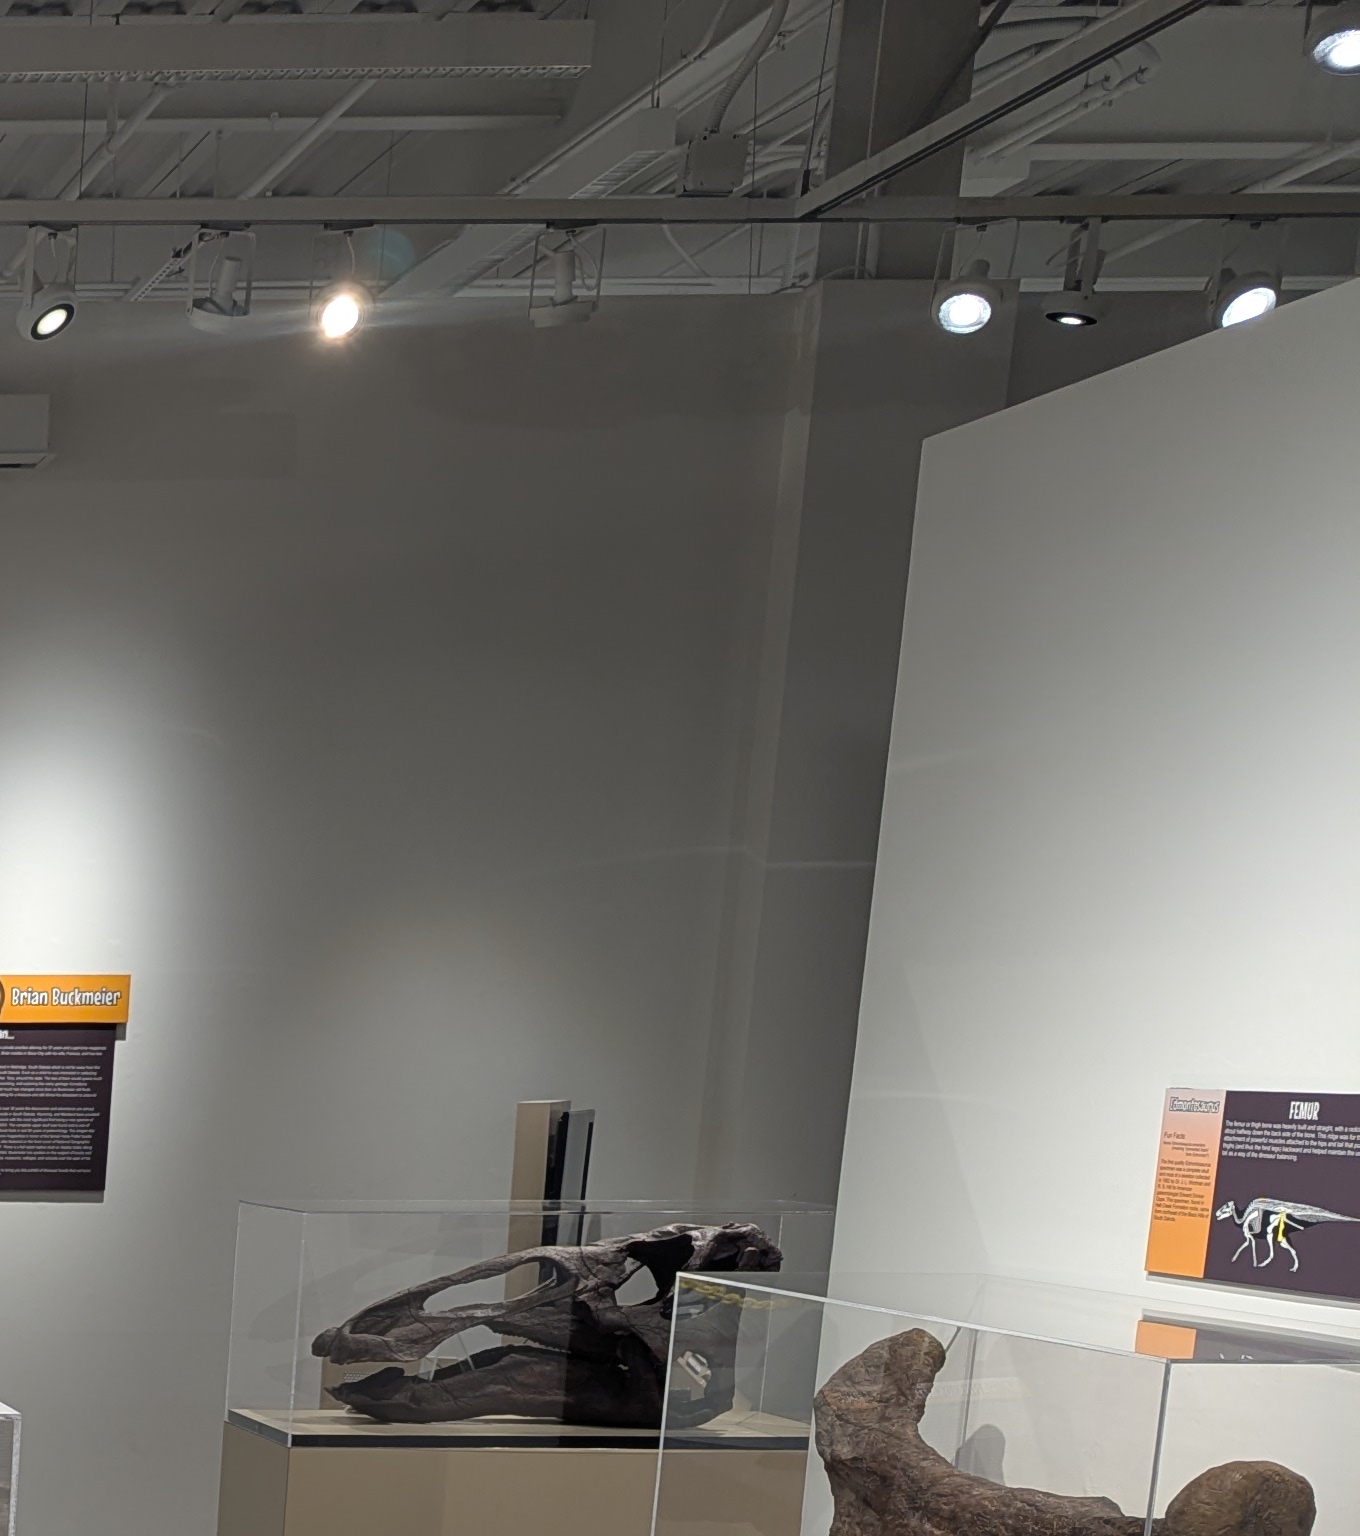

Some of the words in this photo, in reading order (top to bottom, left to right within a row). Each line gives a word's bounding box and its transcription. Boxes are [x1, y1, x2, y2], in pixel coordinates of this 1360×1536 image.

[11, 987, 48, 1006] Brian
[52, 987, 121, 1006] Buckmeier
[1288, 1101, 1320, 1120] FEMUR
